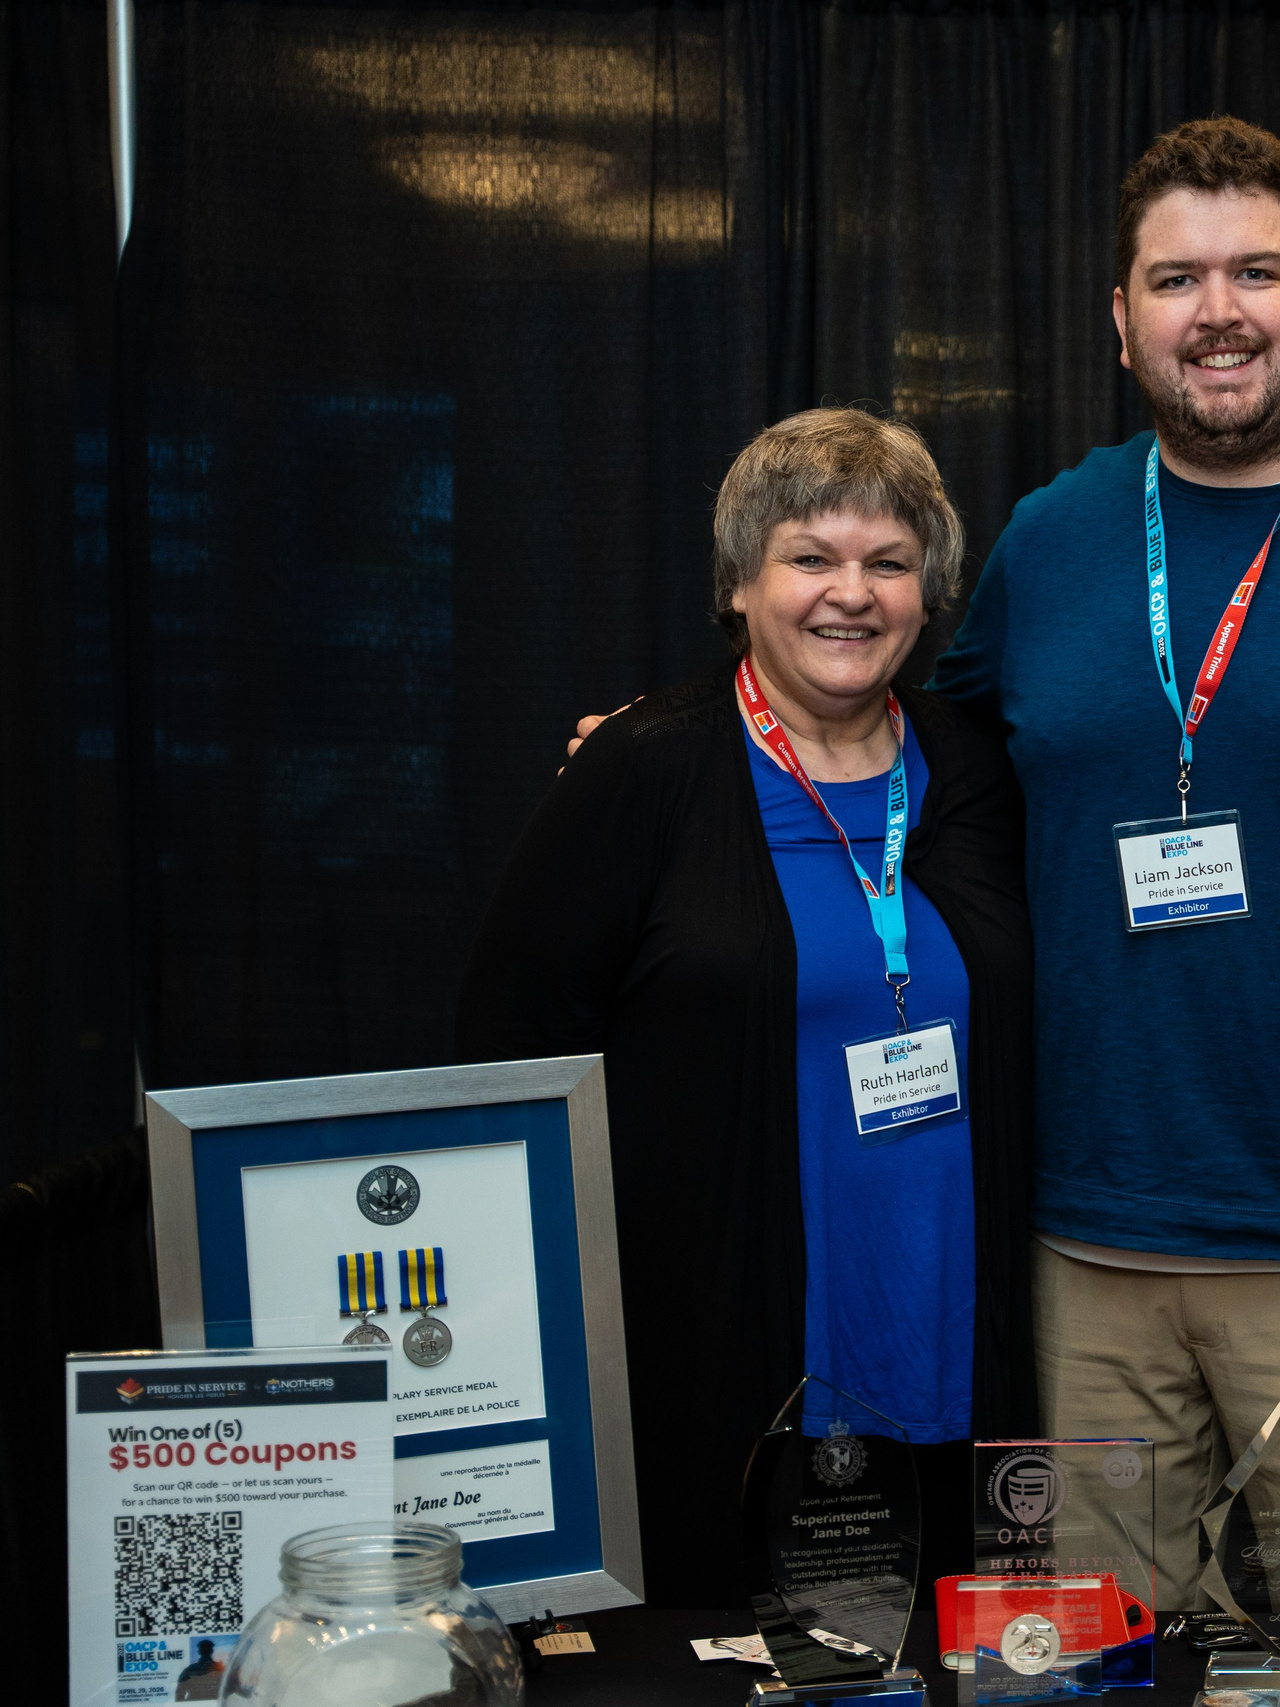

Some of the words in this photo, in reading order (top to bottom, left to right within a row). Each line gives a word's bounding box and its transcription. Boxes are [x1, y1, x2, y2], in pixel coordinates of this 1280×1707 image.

[1146, 446, 1157, 492] EXPO
[1147, 491, 1159, 531] LINE
[1150, 530, 1162, 573] BLUE
[1151, 572, 1164, 588] &
[1151, 592, 1167, 636] OACP
[1216, 621, 1235, 656] Apparel
[1206, 656, 1222, 680] Trims
[742, 673, 758, 703] Insignia
[778, 741, 797, 772] Custom
[891, 773, 905, 811] BLUE
[890, 812, 905, 826] &
[885, 828, 903, 862] OACP
[1165, 836, 1185, 844] OACP
[1166, 843, 1185, 851] BLUE
[1186, 840, 1203, 849] LINE
[1167, 850, 1188, 858] EXPO
[1135, 870, 1170, 885] Liam
[1174, 862, 1233, 879] Jackson
[1148, 887, 1174, 899] Pride
[1177, 886, 1186, 895] in
[1187, 882, 1224, 894] Service
[1168, 903, 1209, 915] Exhibitor
[888, 1040, 906, 1050] OACP
[888, 1048, 906, 1056] BLUE
[907, 1043, 922, 1052] LINE
[889, 1053, 908, 1063] EXPO
[860, 1073, 893, 1092] Ruth
[896, 1059, 948, 1083] Harland
[873, 1093, 896, 1105] Pride
[899, 1091, 907, 1100] in
[909, 1083, 941, 1098] Service
[891, 1105, 928, 1120] Exhibitor
[146, 1384, 181, 1395] PRIDE
[184, 1384, 195, 1393] IN
[198, 1382, 245, 1392] SERVICE
[281, 1378, 334, 1388] NOTHERS
[424, 1385, 464, 1397] SERVICE
[466, 1381, 498, 1392] MEDAL
[396, 1407, 454, 1422] EXEMPLAIRE
[457, 1406, 469, 1415] DE
[472, 1405, 484, 1413] LA
[486, 1399, 520, 1411] POLICE
[108, 1426, 146, 1443] Win
[150, 1425, 188, 1442] One
[191, 1423, 211, 1439] of
[214, 1419, 242, 1443] (5)
[109, 1441, 195, 1472] $500
[204, 1440, 356, 1471] Coupons
[992, 1447, 1032, 1474] ASSOCIATION
[454, 1464, 495, 1476] reproduction
[513, 1459, 540, 1468] médaille
[473, 1471, 503, 1480] décernée
[1109, 1461, 1135, 1478] On
[133, 1482, 155, 1492] Scan
[158, 1483, 174, 1491] our
[177, 1480, 193, 1491] QR
[195, 1480, 219, 1490] code
[232, 1480, 242, 1488] or
[244, 1477, 257, 1487] let
[273, 1478, 294, 1486] scan
[296, 1477, 323, 1487] yours
[122, 1498, 135, 1508] for
[146, 1495, 180, 1506] chance
[183, 1496, 193, 1504] to
[195, 1494, 212, 1503] win
[215, 1493, 240, 1504] $500
[242, 1491, 276, 1502] toward
[279, 1492, 300, 1502] your
[302, 1489, 347, 1500] purchase.
[412, 1496, 448, 1515] Jane
[453, 1491, 481, 1506] Doe
[800, 1498, 821, 1507] Upon
[822, 1497, 839, 1506] your
[841, 1493, 881, 1502] Retirement
[444, 1518, 483, 1529] Gouverneur
[484, 1514, 509, 1524] général
[520, 1510, 544, 1519] Canada
[792, 1508, 890, 1527] Superintendent
[812, 1528, 841, 1539] Jane
[845, 1525, 870, 1536] Doe
[997, 1527, 1063, 1544] OACP
[781, 1550, 788, 1558] In
[790, 1548, 832, 1559] recognition
[826, 1554, 883, 1566] professionalism
[885, 1552, 899, 1560] and
[792, 1569, 836, 1579] outstanding
[863, 1564, 879, 1572] with
[881, 1563, 893, 1571] the
[990, 1558, 1060, 1569] HEROES
[1068, 1556, 1140, 1567] BEYOND
[785, 1582, 813, 1591] Canada
[125, 1641, 157, 1652] OACP
[159, 1641, 167, 1650] &
[1010, 1624, 1052, 1664] 25
[125, 1651, 155, 1662] BLUE
[157, 1650, 183, 1661] LINE
[125, 1661, 158, 1672] EXPO
